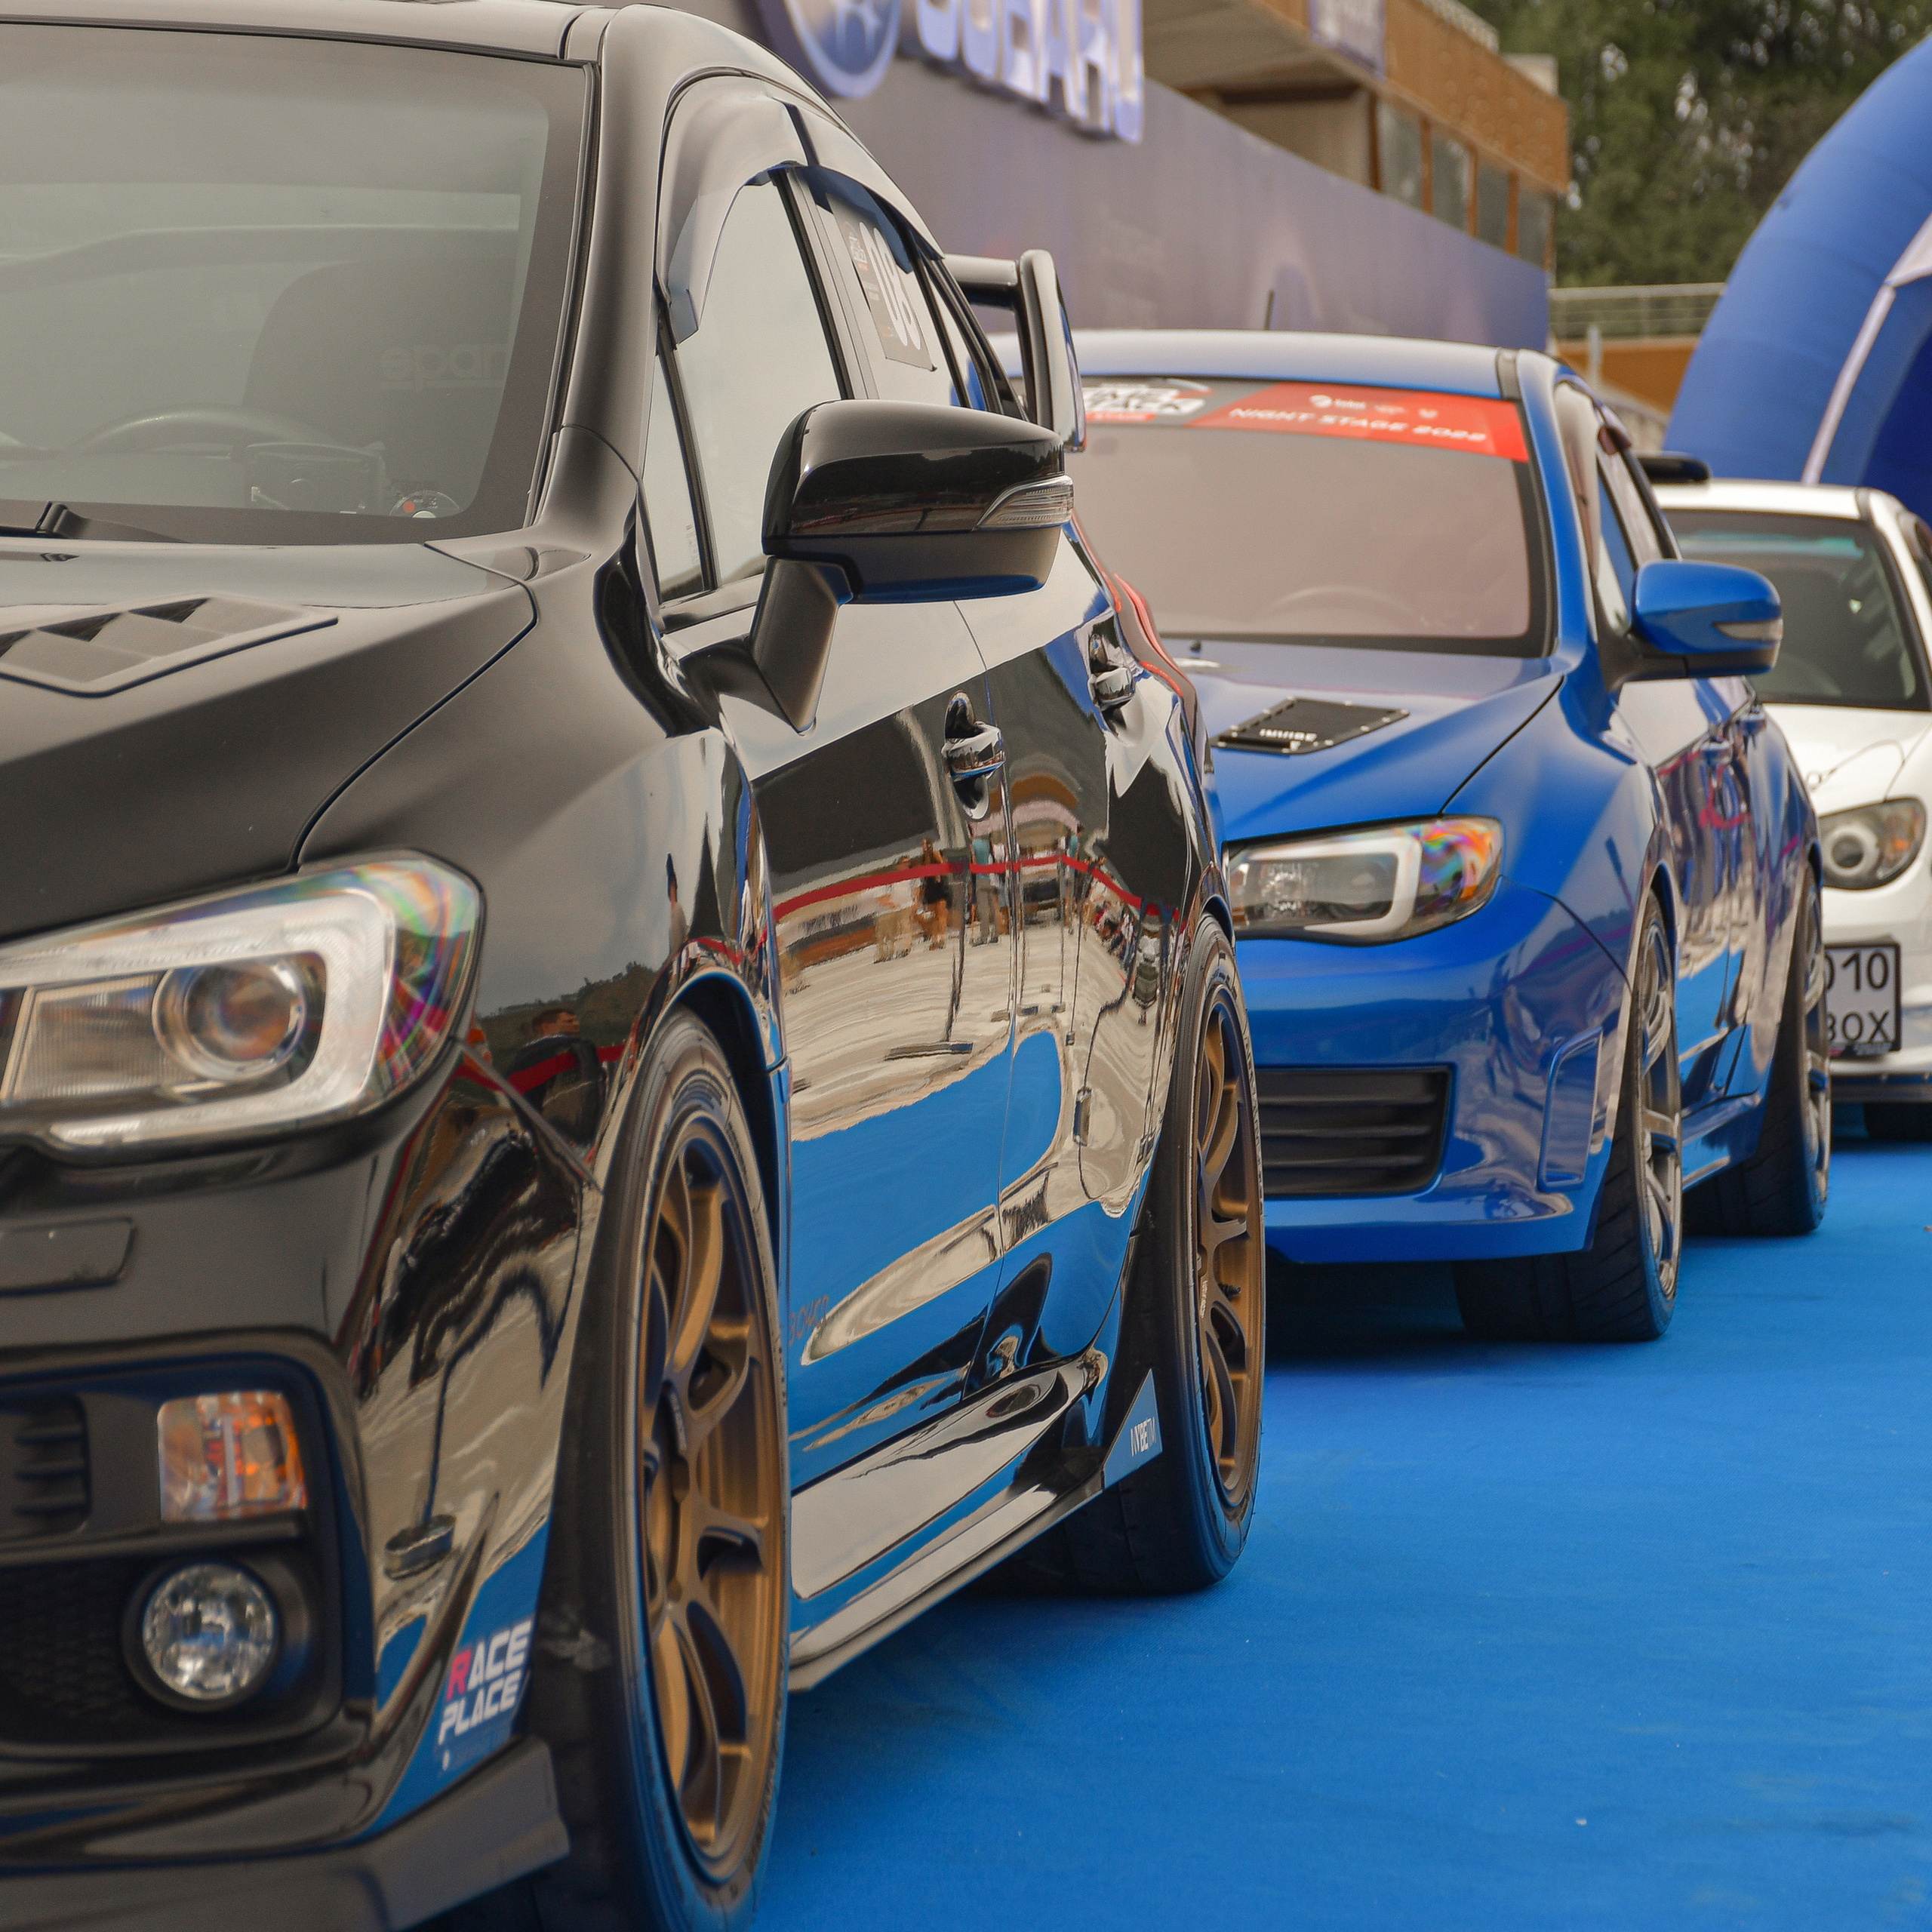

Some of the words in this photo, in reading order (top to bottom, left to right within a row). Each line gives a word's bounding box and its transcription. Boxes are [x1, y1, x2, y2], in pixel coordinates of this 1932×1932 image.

[1229, 408, 1315, 423] NIGHT
[1319, 414, 1409, 432] STAGE
[1412, 425, 1487, 442] 2022
[446, 1620, 533, 1701] RACE
[437, 1669, 522, 1746] PLACE
